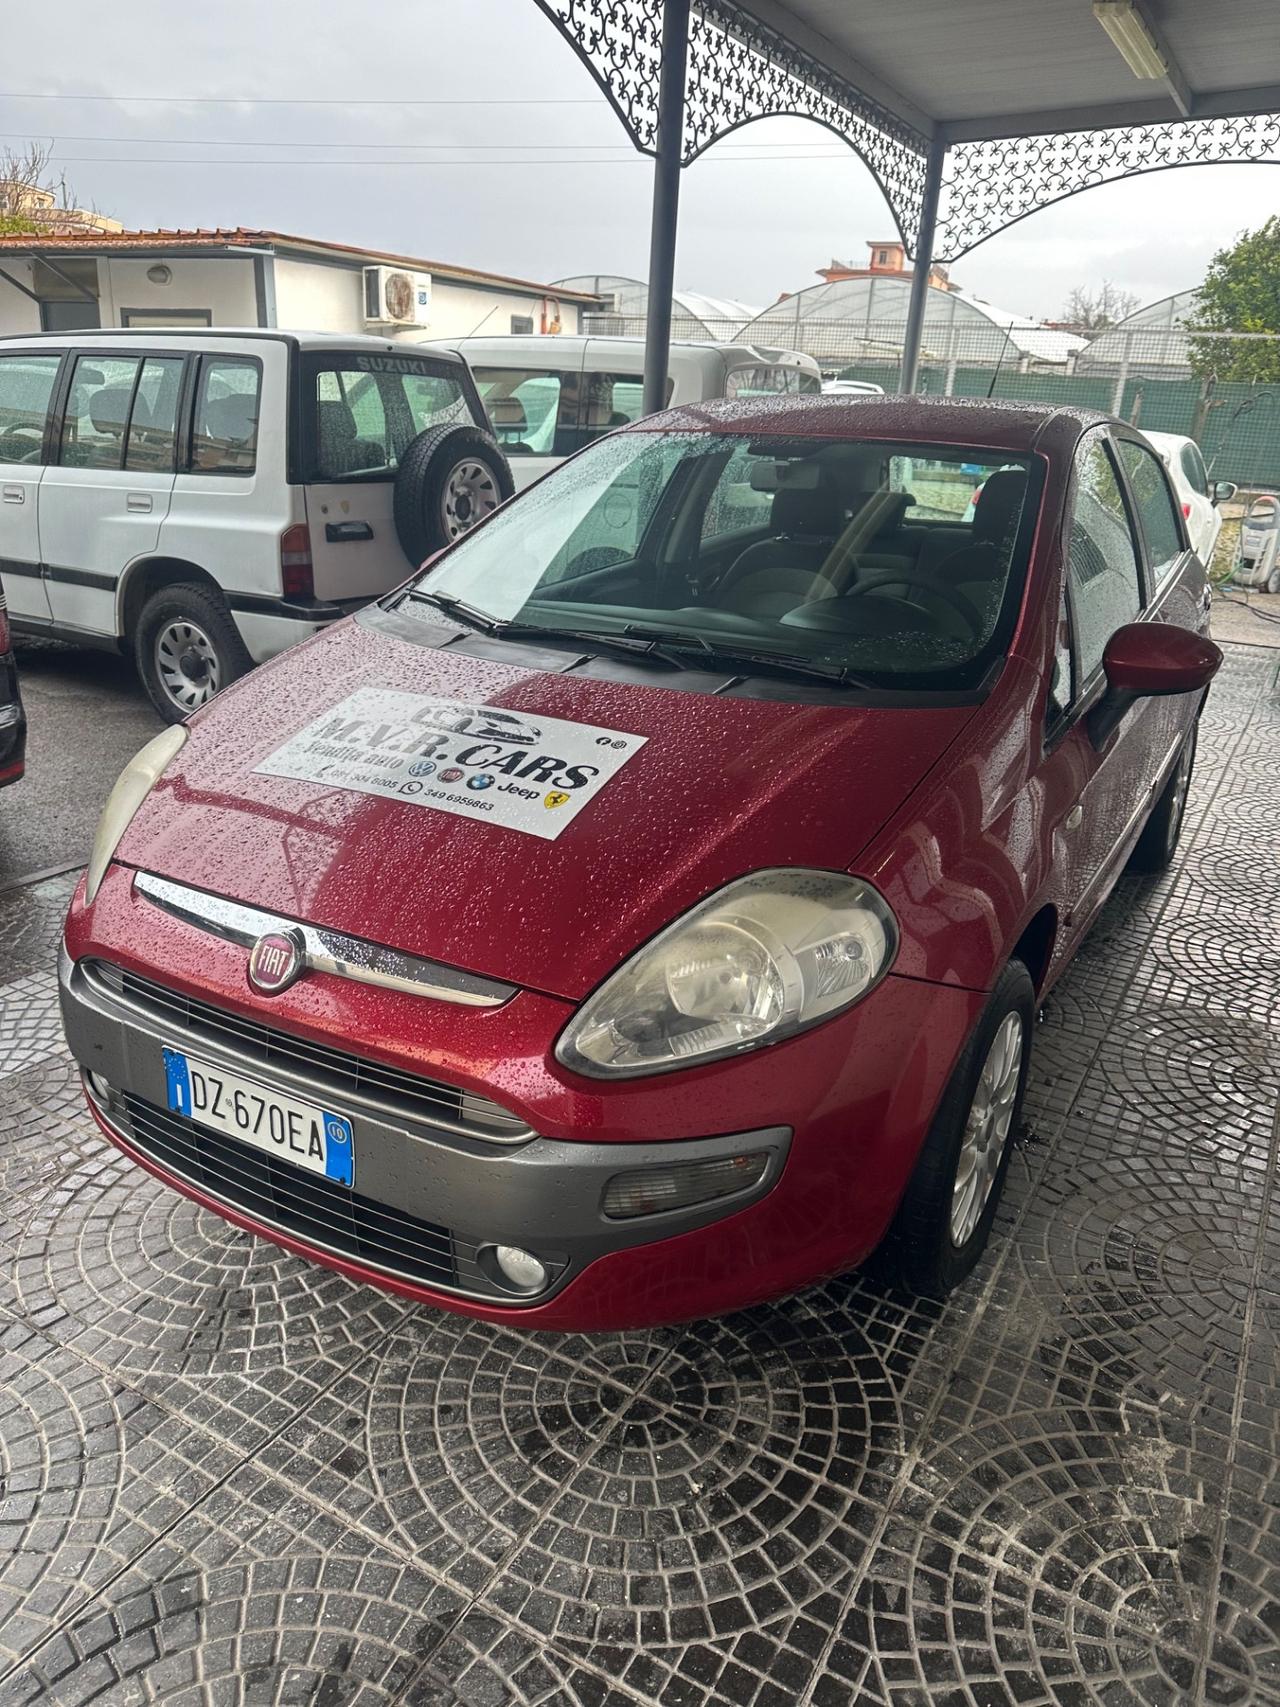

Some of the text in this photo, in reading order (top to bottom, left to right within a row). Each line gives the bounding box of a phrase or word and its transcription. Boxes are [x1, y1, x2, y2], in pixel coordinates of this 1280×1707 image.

[356, 355, 427, 374] SUZUKI
[455, 743, 600, 790] CARS
[423, 788, 495, 811] 349 6959863
[497, 782, 541, 801] Jeep
[258, 945, 290, 976] FIAT
